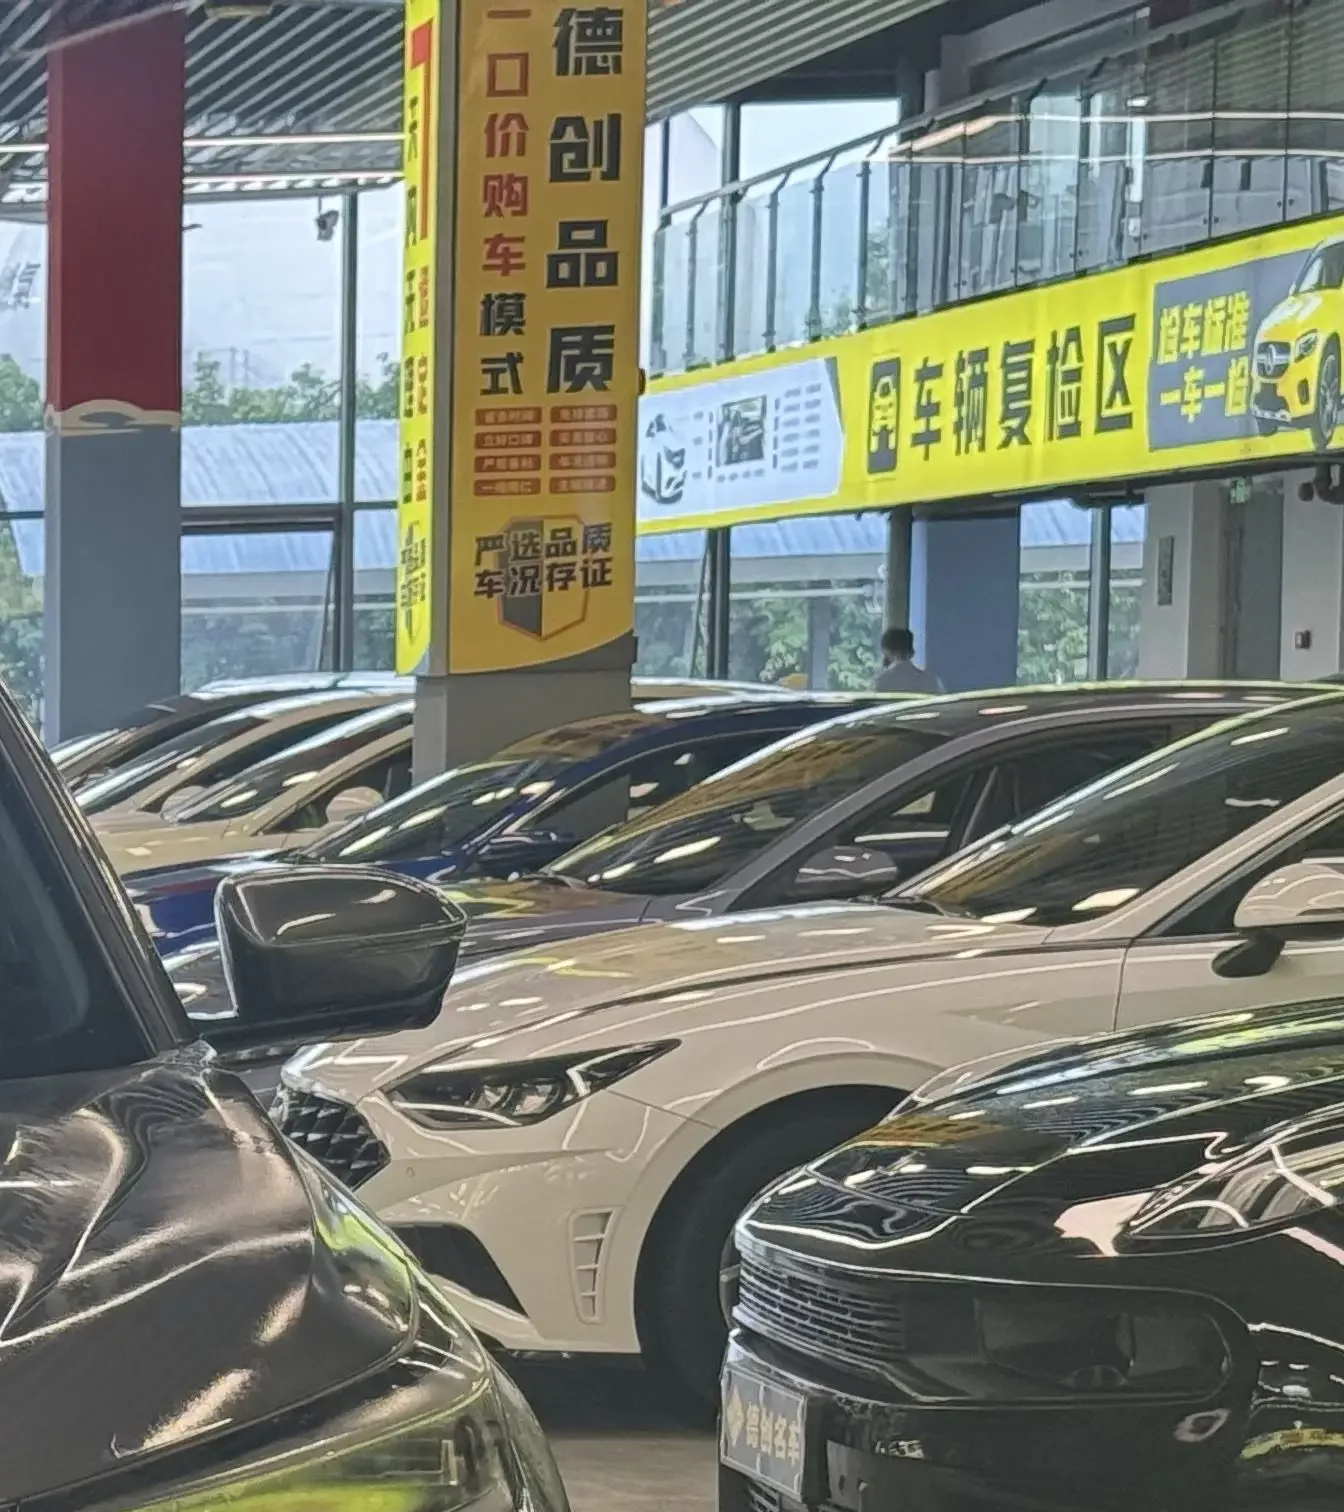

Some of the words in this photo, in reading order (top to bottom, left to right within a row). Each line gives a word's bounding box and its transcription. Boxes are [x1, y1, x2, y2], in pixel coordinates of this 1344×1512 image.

[479, 8, 532, 396] 一口价购车模式
[546, 5, 625, 394] 德创品质
[910, 313, 1137, 461] 车辆复检区
[473, 556, 614, 599] 车况存证
[475, 522, 613, 566] 严选品质
